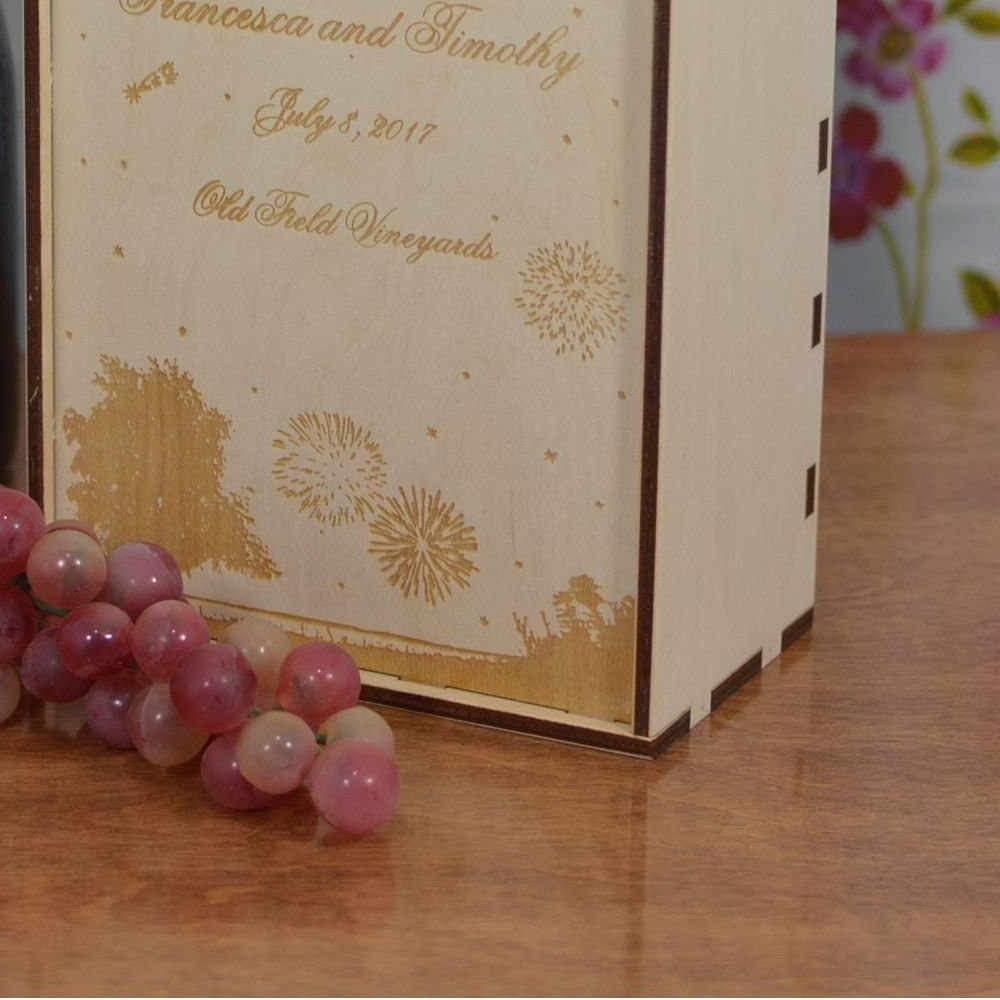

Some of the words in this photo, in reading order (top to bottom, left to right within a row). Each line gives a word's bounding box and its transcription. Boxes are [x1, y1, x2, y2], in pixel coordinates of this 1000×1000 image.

[317, 12, 404, 48] and
[404, 0, 583, 91] Timothy
[252, 87, 336, 144] July
[337, 109, 362, 142] 8,
[367, 113, 438, 145] 2017
[193, 180, 253, 223] Old
[254, 189, 341, 236] Field
[344, 202, 500, 265] Vineyards
